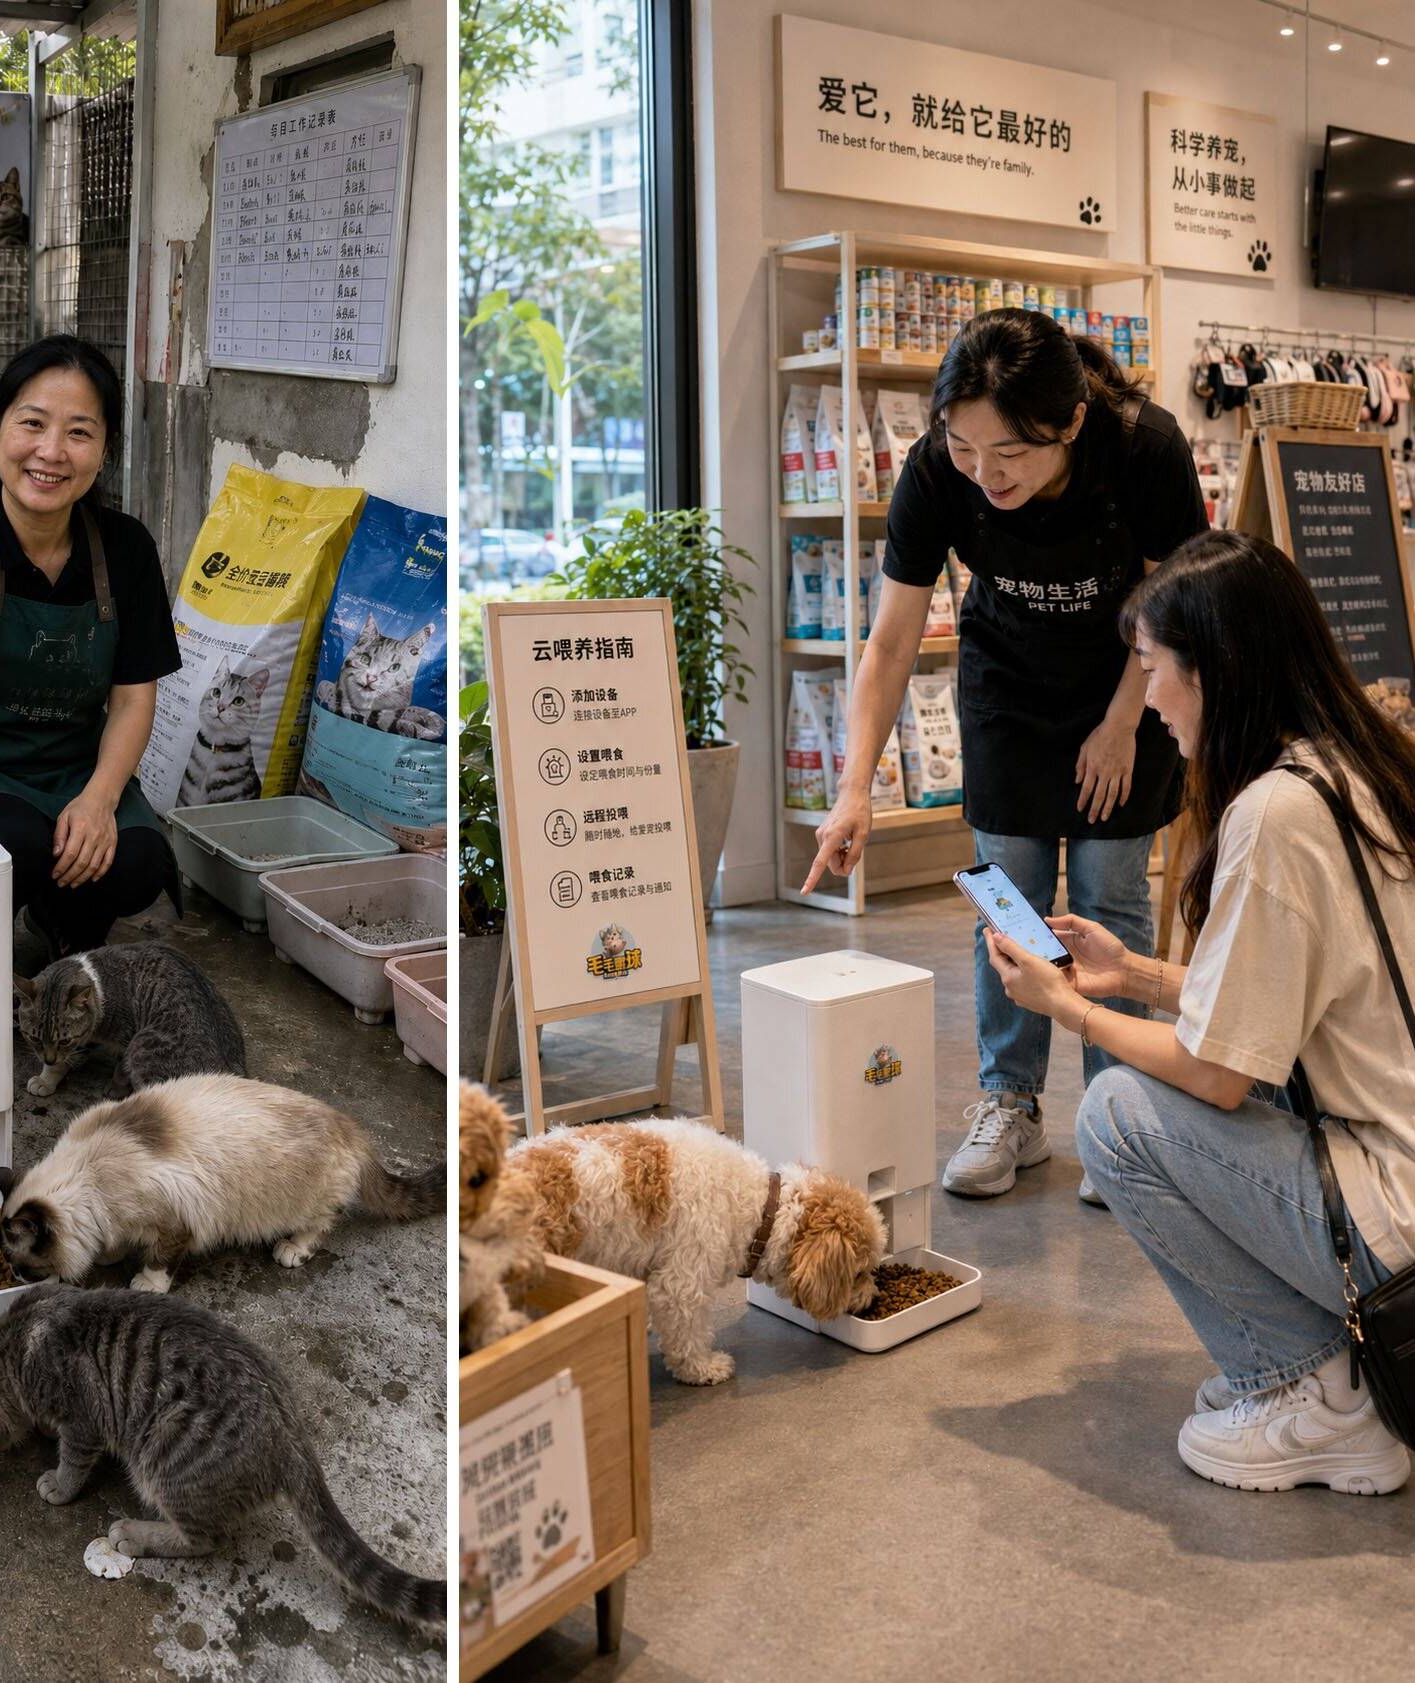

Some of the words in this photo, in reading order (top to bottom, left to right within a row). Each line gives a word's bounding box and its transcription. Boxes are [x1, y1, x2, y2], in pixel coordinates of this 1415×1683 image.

[818, 76, 1071, 153] 爱它，就给它最好的
[817, 129, 840, 145] The
[843, 133, 867, 149] best
[870, 137, 886, 152] for
[889, 141, 920, 159] them,
[922, 146, 964, 164] because
[966, 153, 1001, 172] they're
[1003, 158, 1035, 178] family.
[1171, 128, 1246, 166] 科学养宠，
[1172, 166, 1255, 201] 从小事做起
[1174, 202, 1198, 215] Better
[1199, 208, 1216, 218] care
[1217, 210, 1239, 221] starts
[1240, 213, 1256, 224] with
[1174, 220, 1187, 232] the
[1189, 222, 1206, 234] little
[1208, 223, 1234, 240] things.
[1294, 470, 1365, 493] 宠物友好店
[994, 576, 1099, 600] 宠物生活
[1028, 601, 1056, 612] PET
[1060, 601, 1091, 612] LIFE
[532, 636, 634, 661] 云喂养指南
[571, 688, 618, 703] 添加设备
[577, 747, 624, 763] 设置喂食
[583, 806, 629, 824] 远程投喂
[589, 866, 635, 884] 喂食记录
